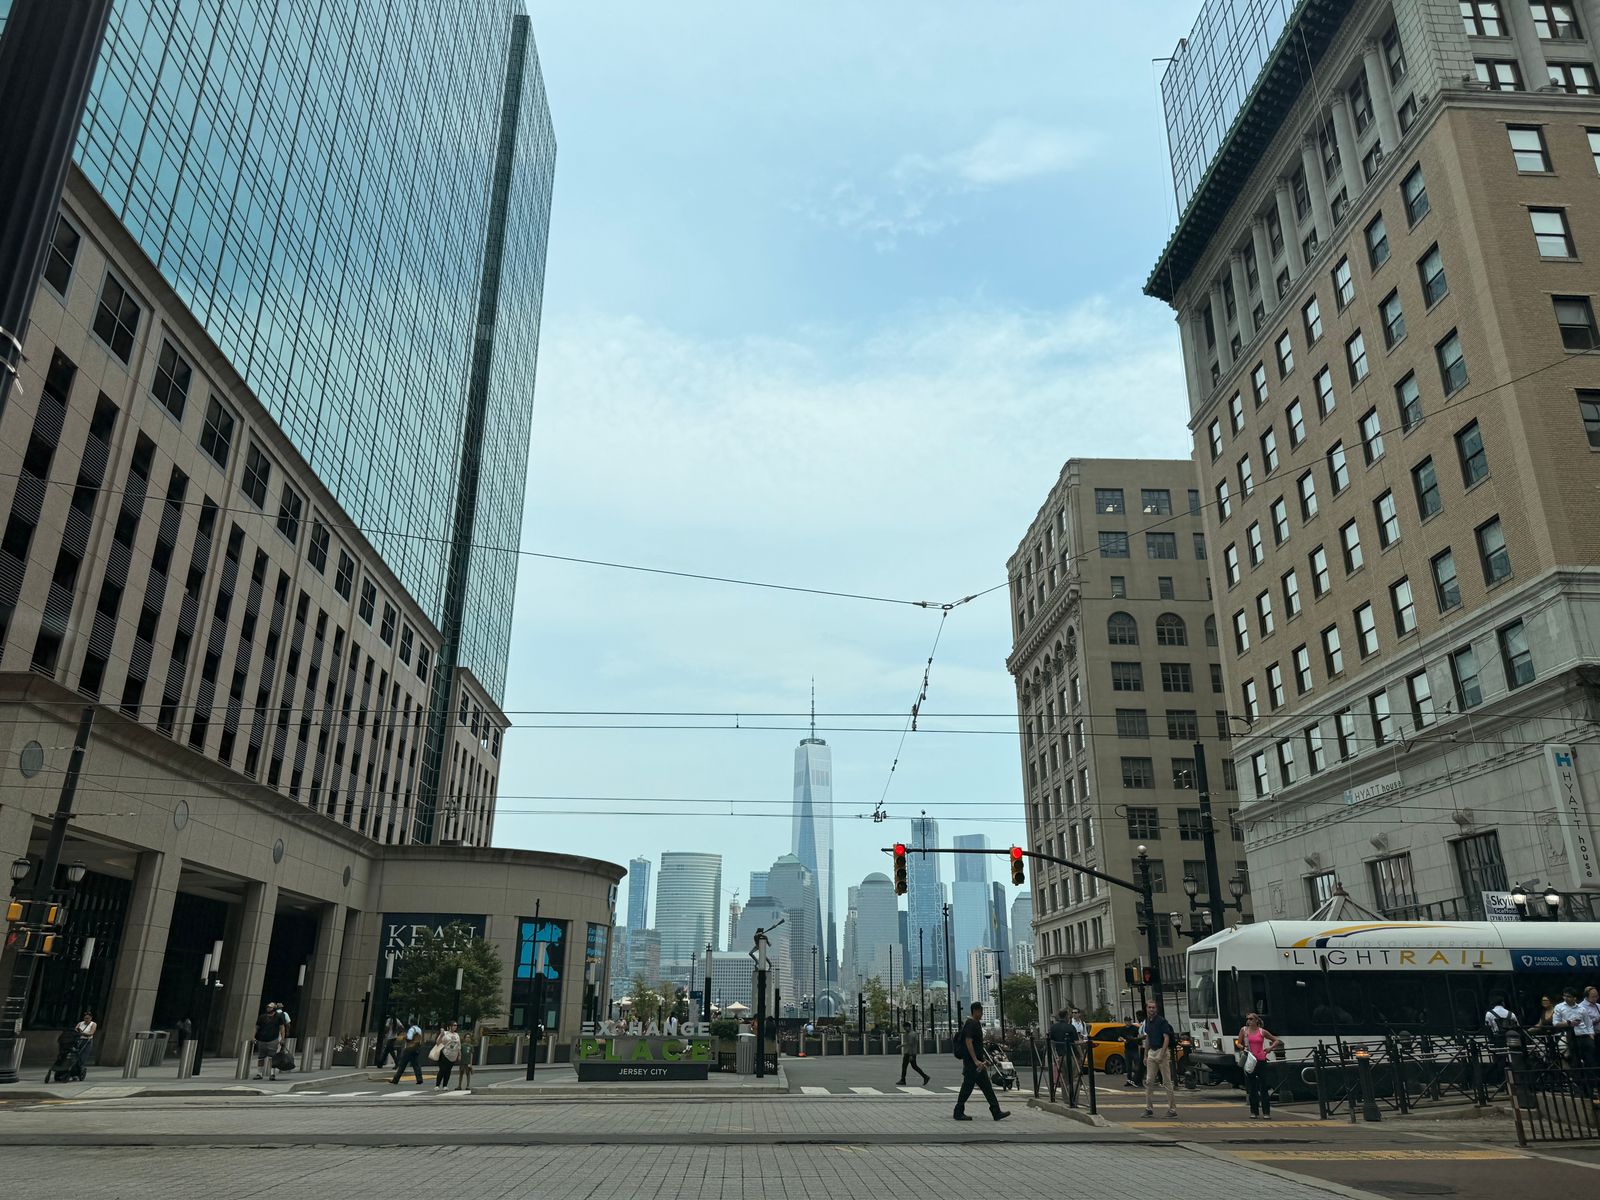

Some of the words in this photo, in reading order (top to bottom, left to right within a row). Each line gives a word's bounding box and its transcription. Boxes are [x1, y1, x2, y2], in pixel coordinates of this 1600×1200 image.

[1354, 784, 1380, 802] HYATT
[1381, 780, 1402, 793] house
[1562, 771, 1580, 830] HYATT
[1578, 835, 1593, 877] house
[1490, 895, 1516, 908] Skyli
[386, 924, 477, 948] KEAN
[1580, 954, 1598, 966] BET
[582, 1021, 710, 1036] EXCHANGE
[580, 1039, 710, 1061] PLACE
